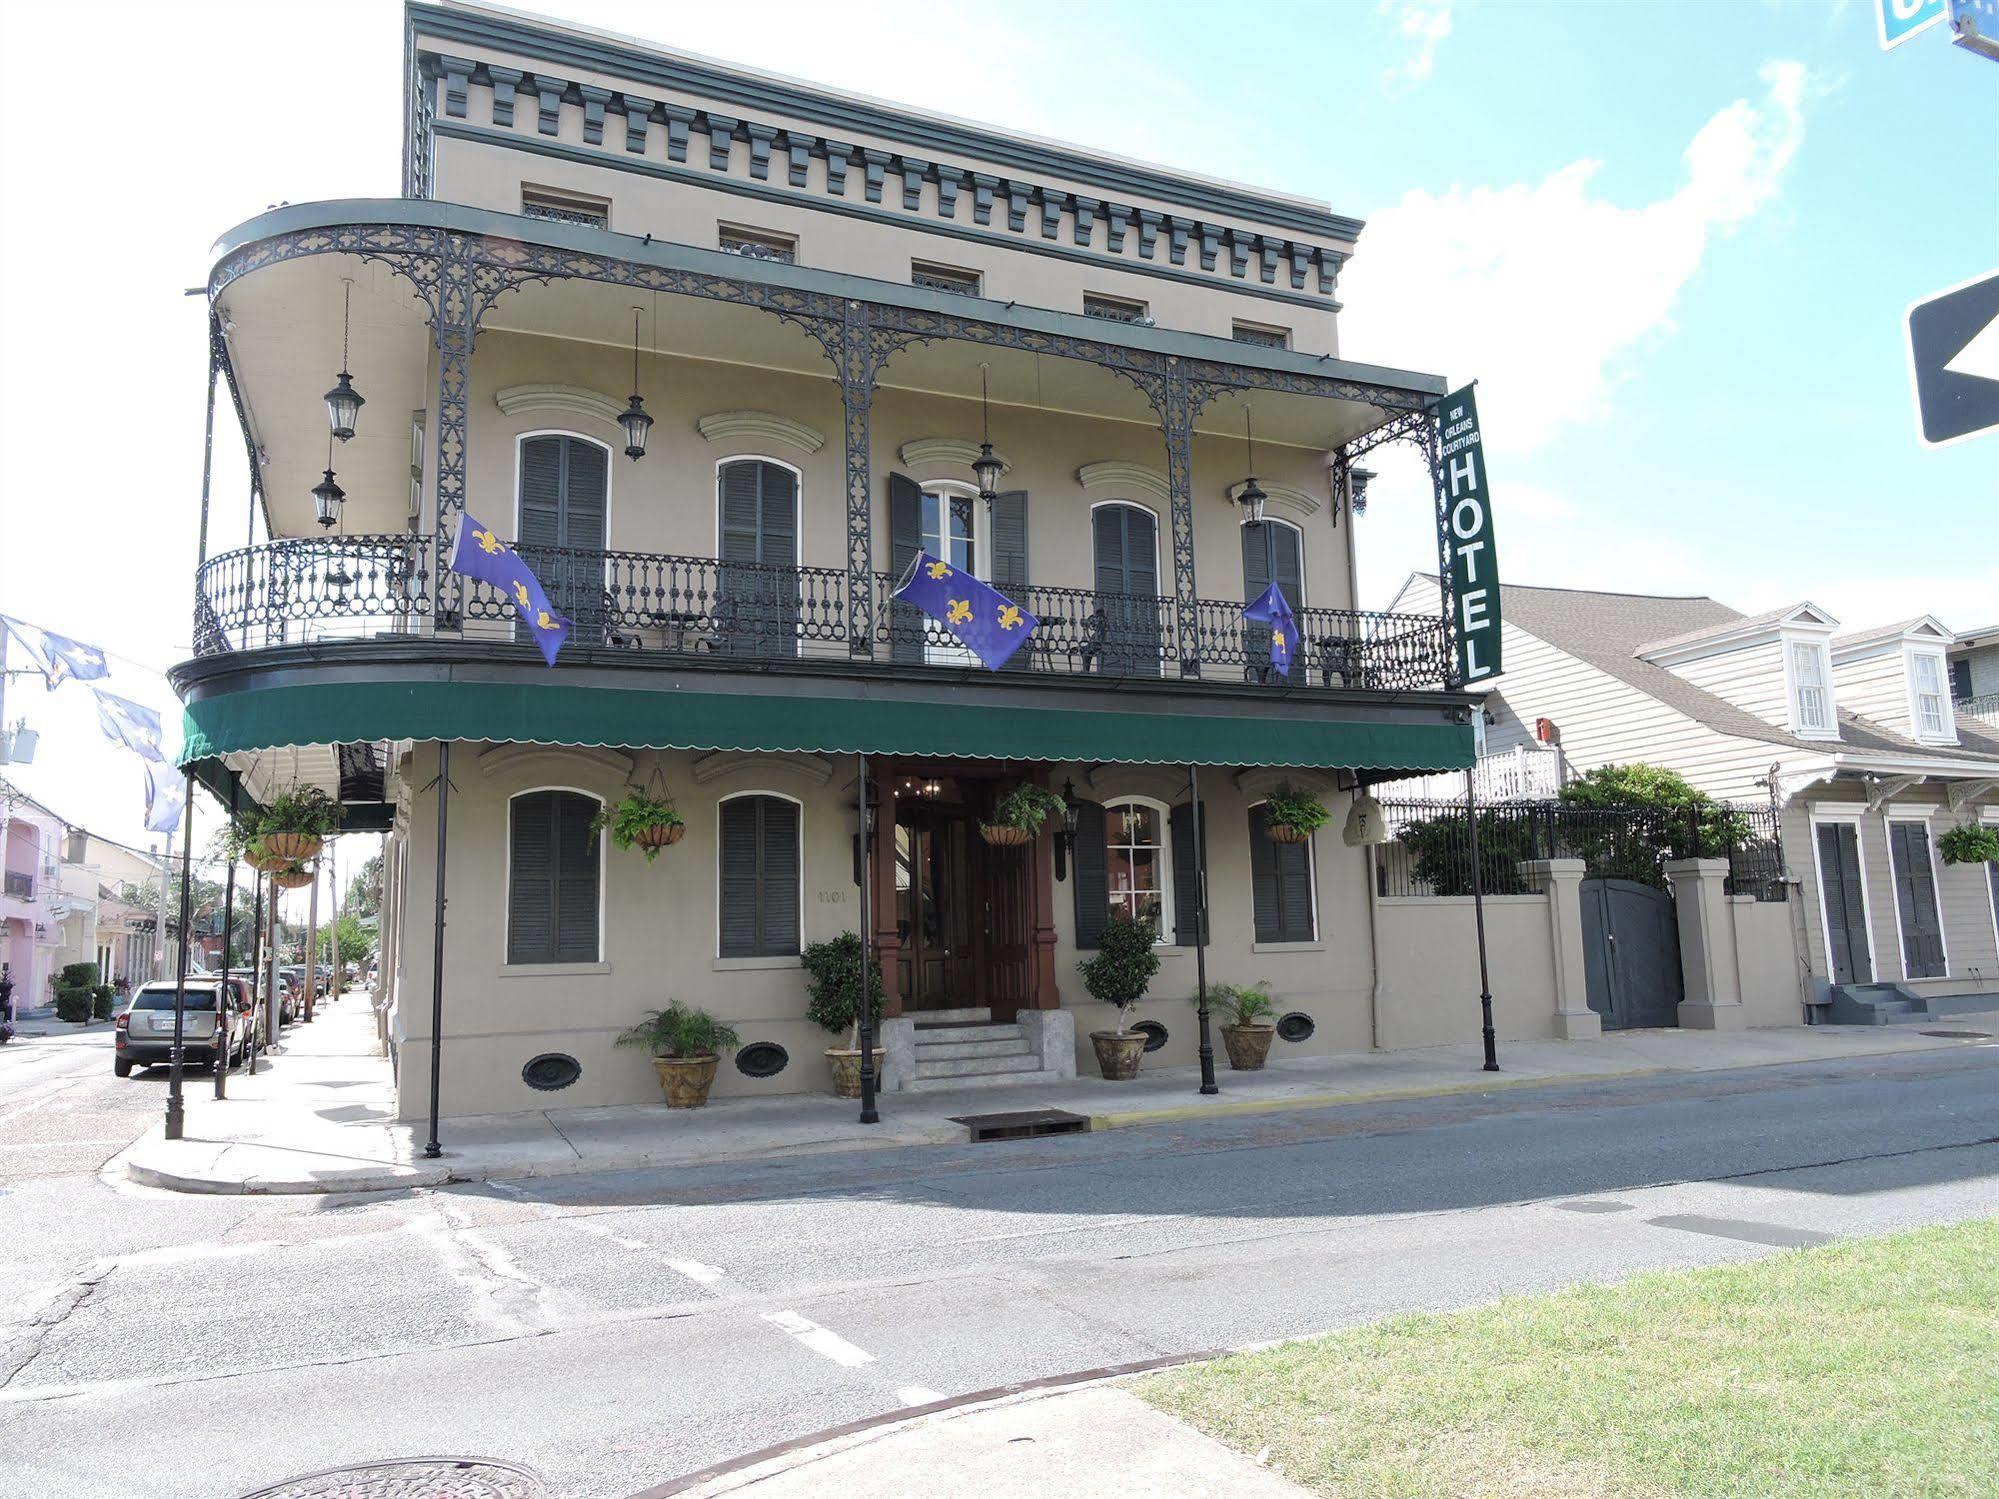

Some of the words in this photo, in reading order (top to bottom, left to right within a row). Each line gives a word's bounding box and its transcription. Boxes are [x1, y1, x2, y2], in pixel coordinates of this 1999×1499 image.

[1450, 406, 1463, 421] NEW
[1445, 418, 1473, 440] ORLEANS
[1442, 431, 1480, 457] COURTYARD
[1450, 452, 1491, 679] HOTEL
[818, 891, 846, 903] 1101
